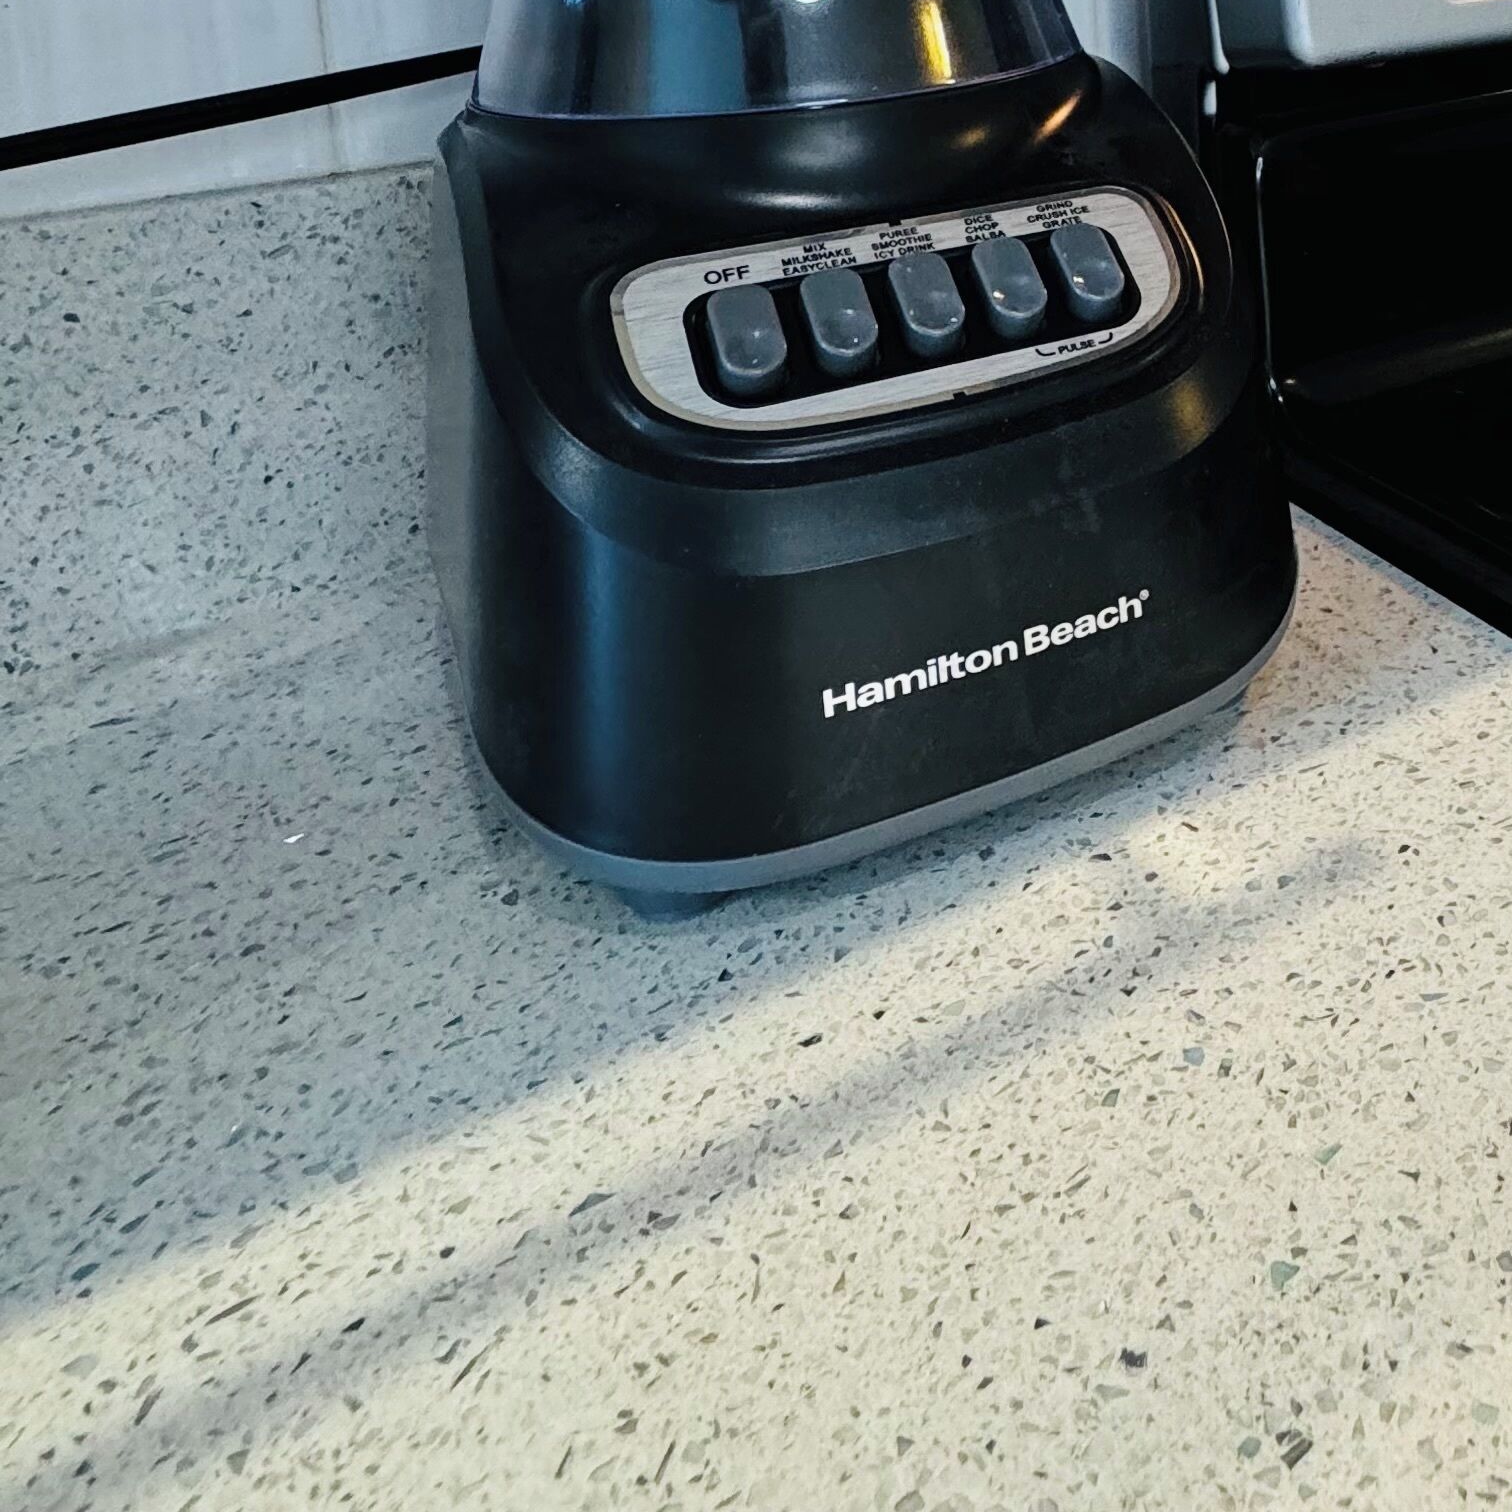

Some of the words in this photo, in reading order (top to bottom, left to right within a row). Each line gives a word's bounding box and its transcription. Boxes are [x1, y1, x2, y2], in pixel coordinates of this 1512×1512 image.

[1036, 200, 1073, 213] GRIND
[964, 214, 994, 226] DICE
[1026, 210, 1068, 224] CRUSH
[1070, 205, 1091, 215] ICE
[1042, 215, 1082, 229] GRATE
[878, 226, 919, 240] PUREE
[964, 222, 1000, 235] CHOP
[871, 233, 933, 251] SMOOTHIE
[965, 230, 1007, 243] SALSA
[802, 242, 827, 254] MIX
[873, 249, 895, 260] ICY
[898, 242, 936, 257] DRINK
[781, 247, 853, 267] MILKSHAKE
[782, 256, 858, 277] EASYCLEAN
[704, 264, 750, 285] OFF
[1057, 339, 1097, 354] PULSE
[822, 640, 1019, 719] Hamilton
